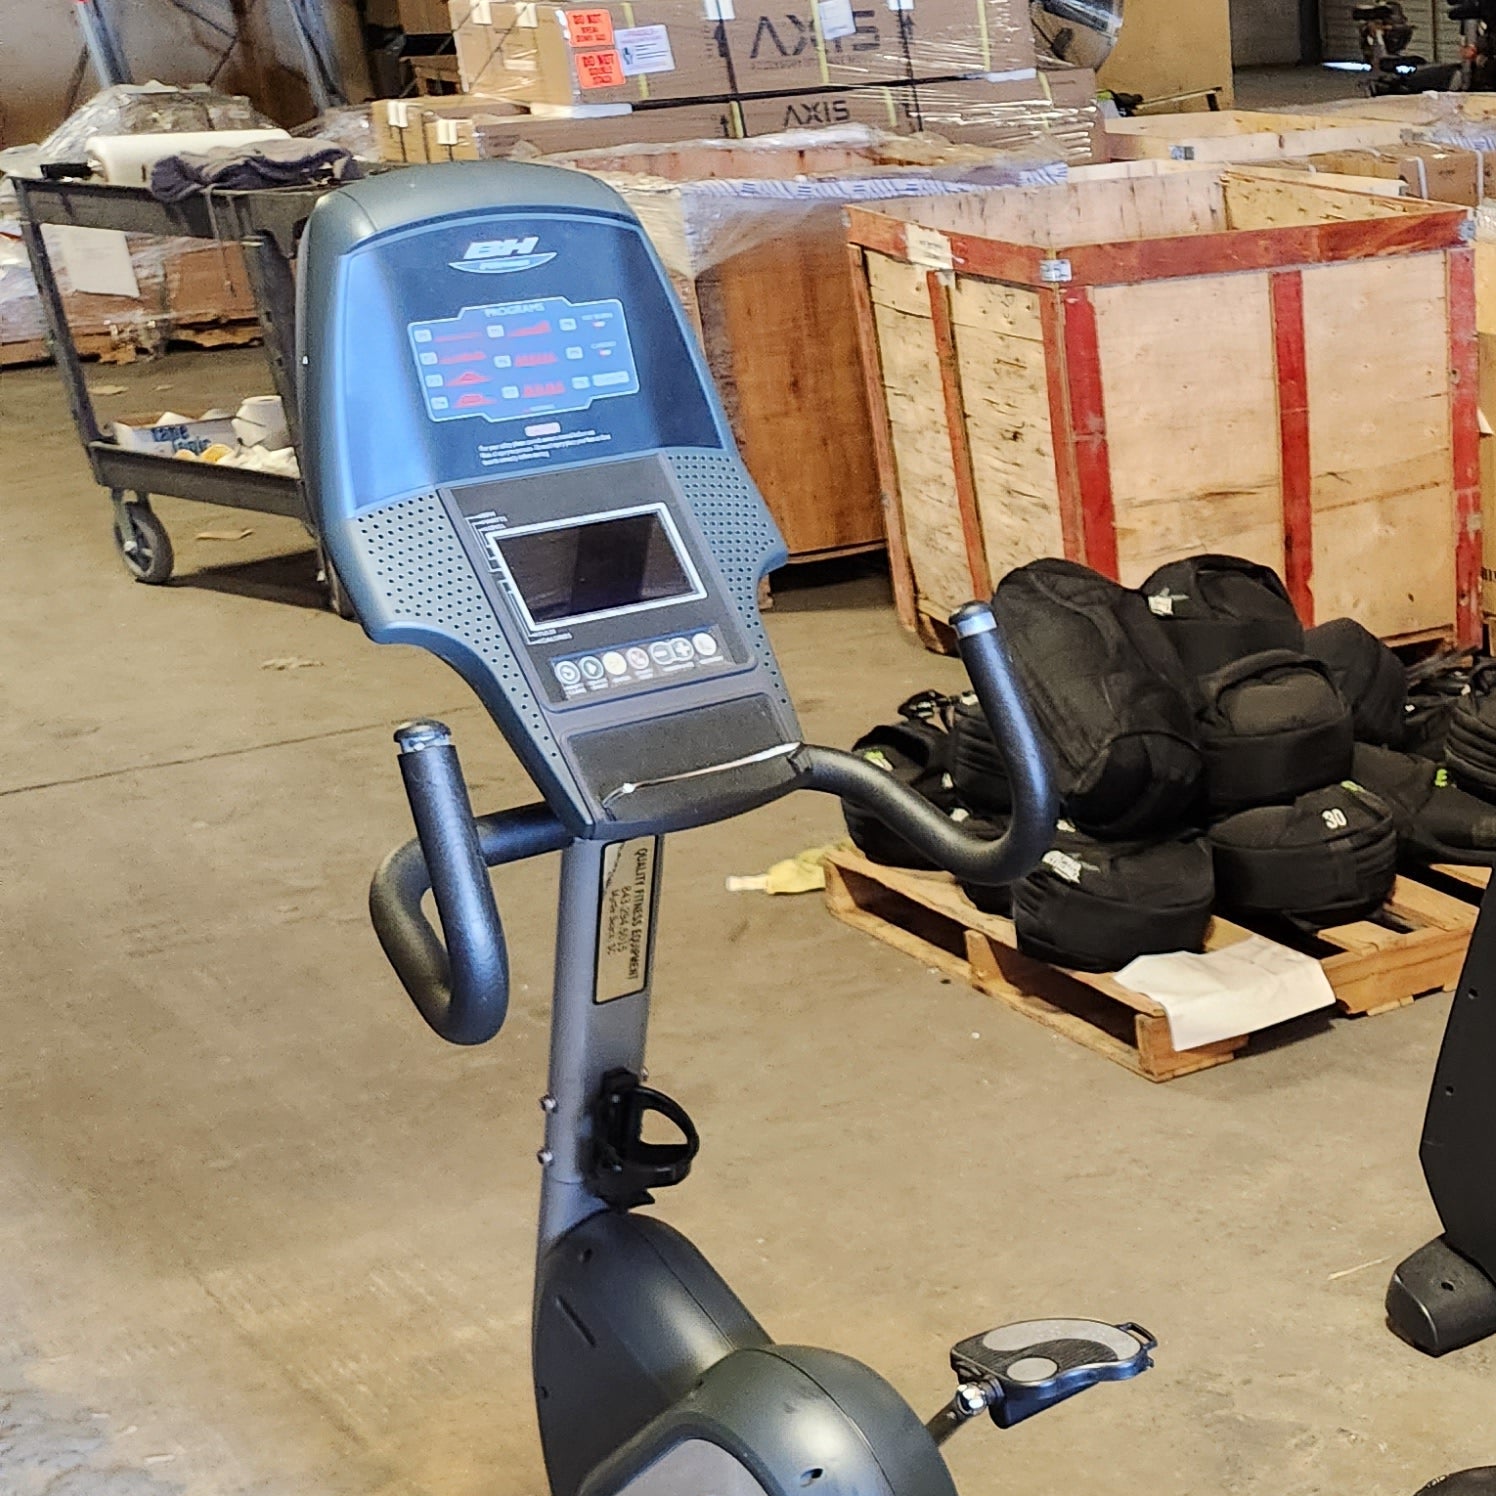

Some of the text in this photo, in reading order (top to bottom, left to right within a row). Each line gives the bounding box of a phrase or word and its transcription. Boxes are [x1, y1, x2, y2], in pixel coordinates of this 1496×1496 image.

[784, 100, 849, 128] AXIS
[463, 236, 540, 260] BH
[484, 302, 545, 317] PROGRAMS
[1322, 808, 1347, 829] 30
[634, 847, 648, 886] QUALITY
[632, 888, 645, 926] FITNESS
